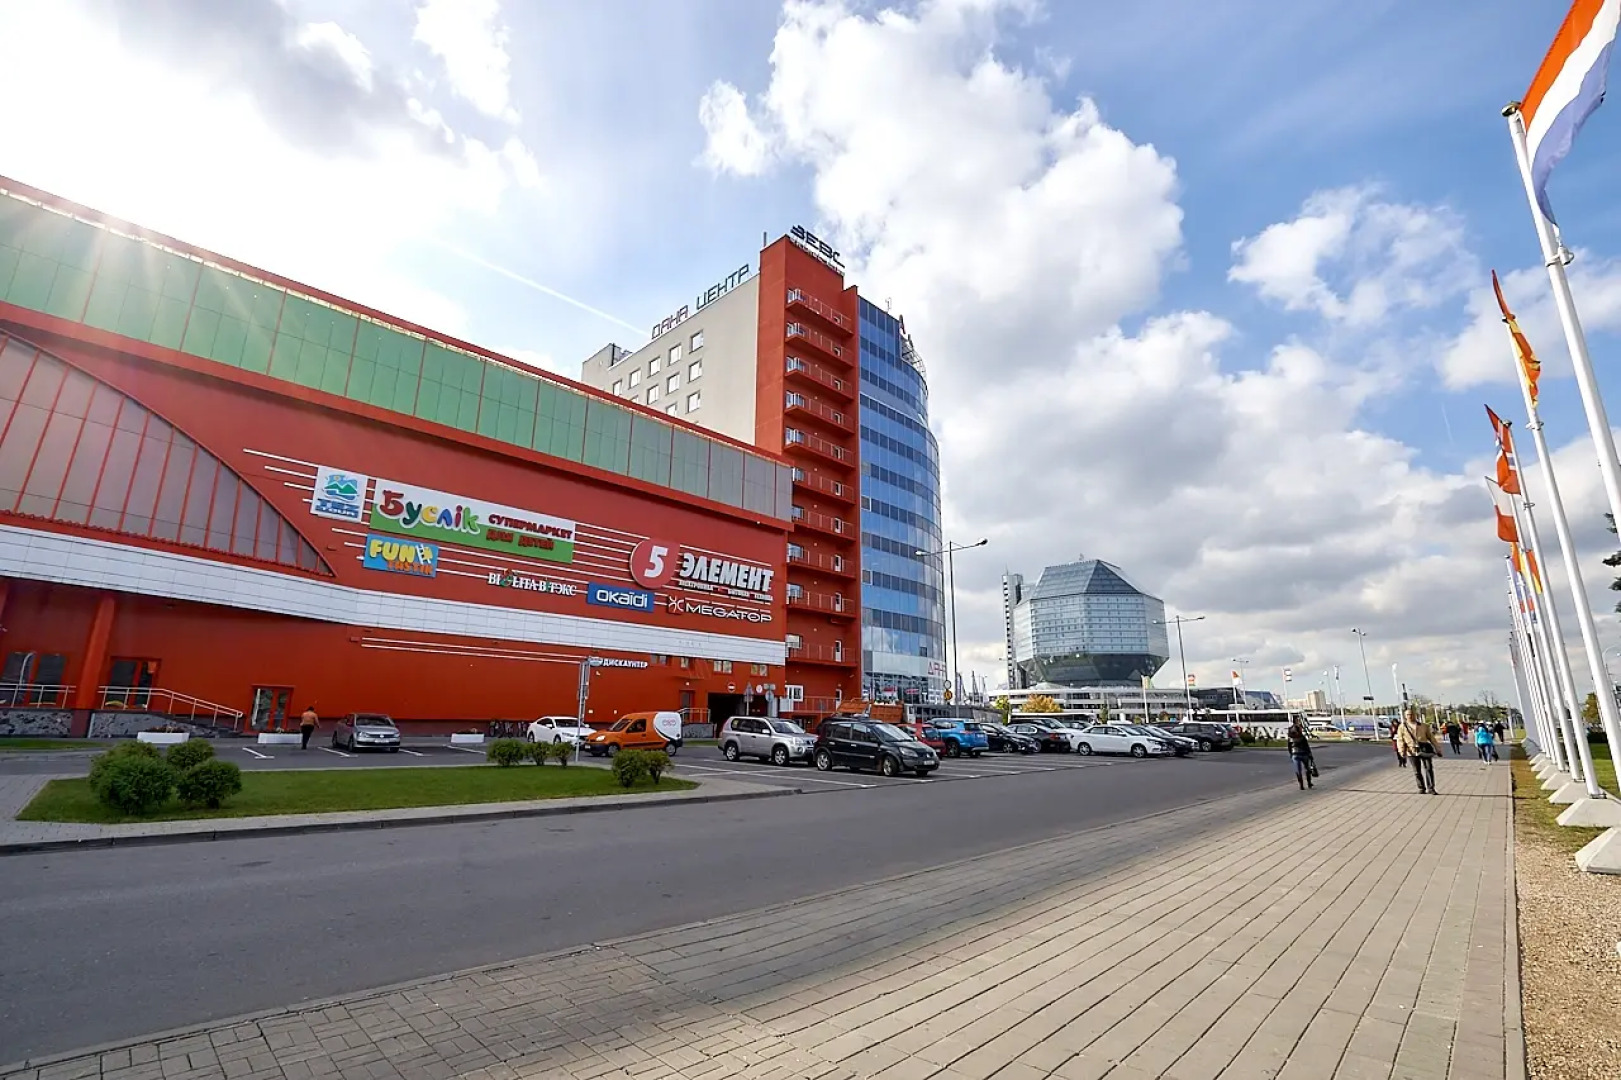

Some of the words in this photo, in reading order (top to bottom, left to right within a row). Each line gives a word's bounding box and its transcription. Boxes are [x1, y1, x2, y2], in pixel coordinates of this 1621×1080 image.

[696, 263, 750, 310] ЦЕНТР
[379, 489, 480, 532] Буслік
[488, 513, 573, 540] СУПЕРМАРКЕТ
[370, 539, 416, 563] FUN
[485, 528, 514, 544] ДЛЯ
[518, 534, 555, 551] ДЕТЕЙ
[643, 545, 669, 578] 5
[679, 552, 774, 592] ЭЛЕМЕНТ
[685, 602, 772, 623] MEGATOP
[603, 658, 648, 669] ДИСКАУНТЕР
